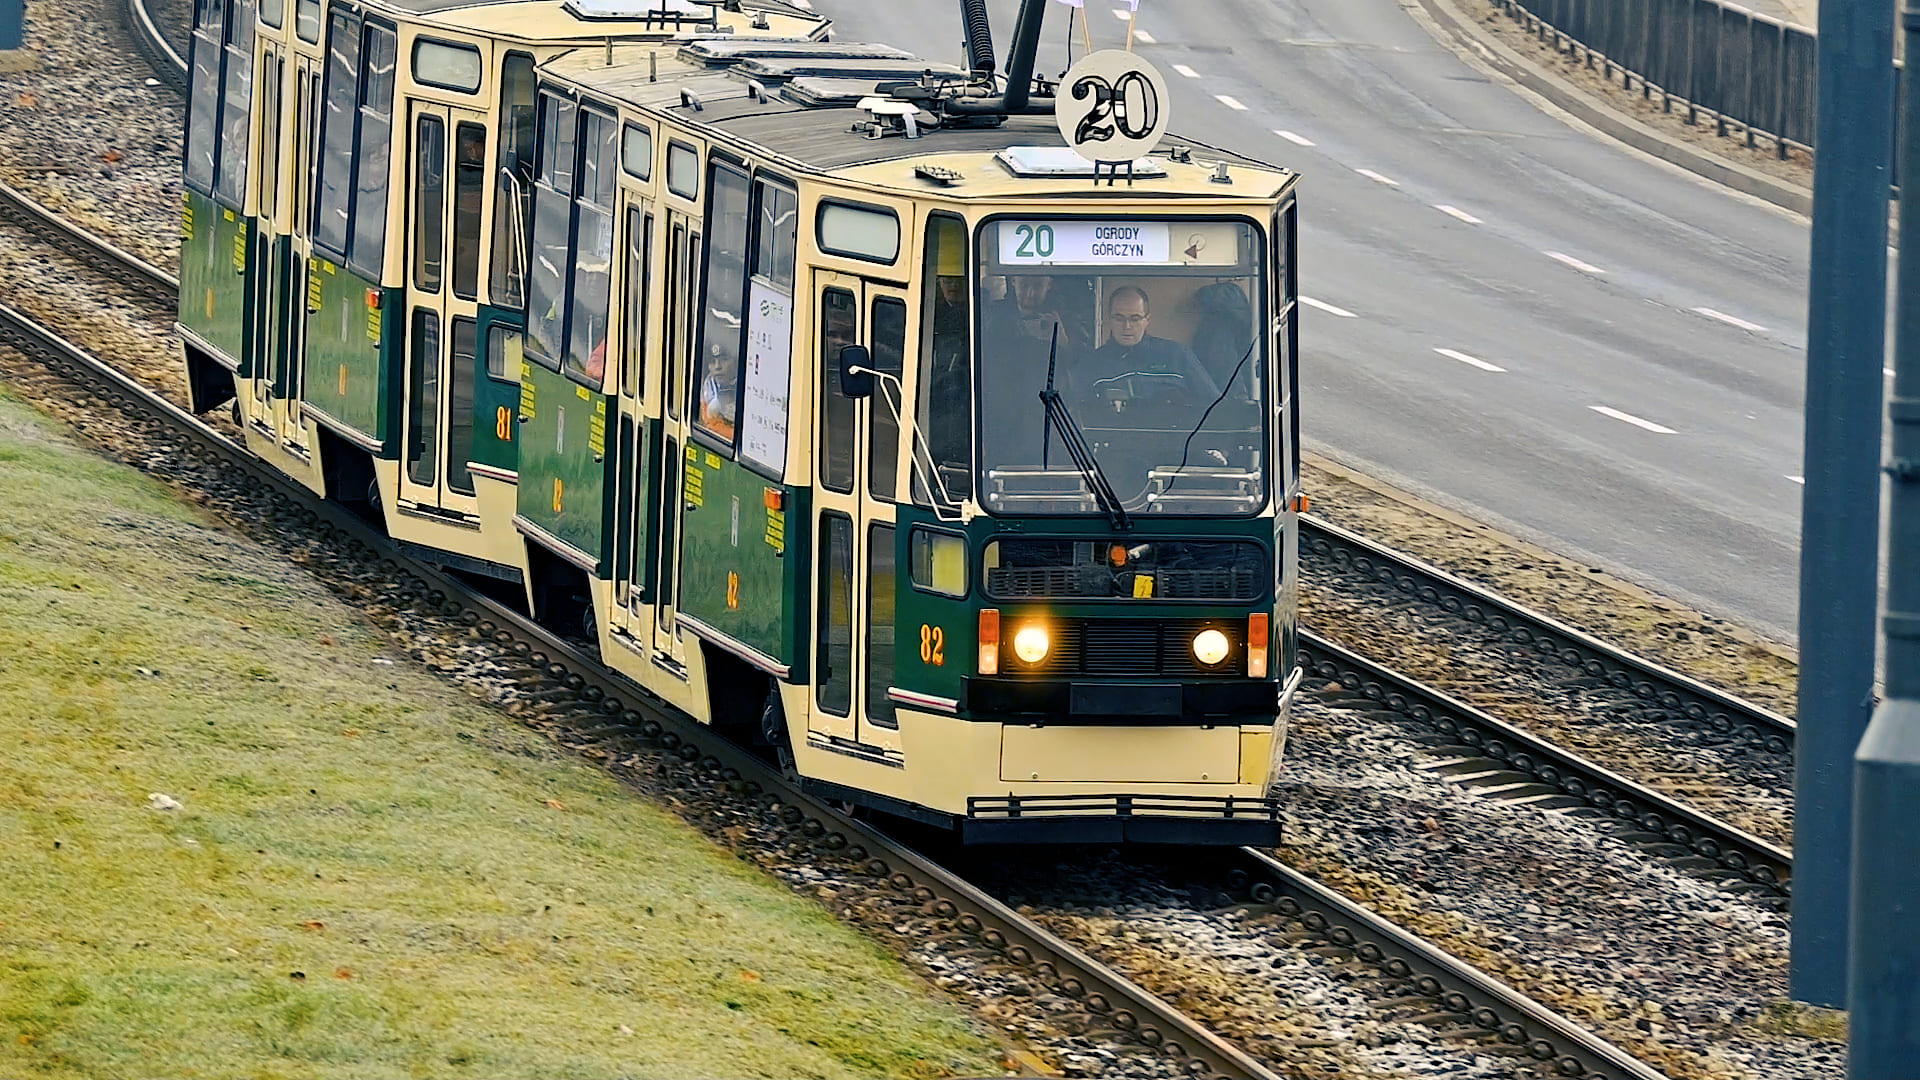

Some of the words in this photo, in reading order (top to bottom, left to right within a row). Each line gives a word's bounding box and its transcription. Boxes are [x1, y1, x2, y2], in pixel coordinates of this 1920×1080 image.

[1071, 70, 1158, 145] 20
[1015, 224, 1054, 258] 20
[1091, 241, 1144, 257] GÓRCZYN
[1095, 227, 1140, 240] OGRODY
[496, 405, 512, 442] 81
[920, 624, 944, 666] 82
